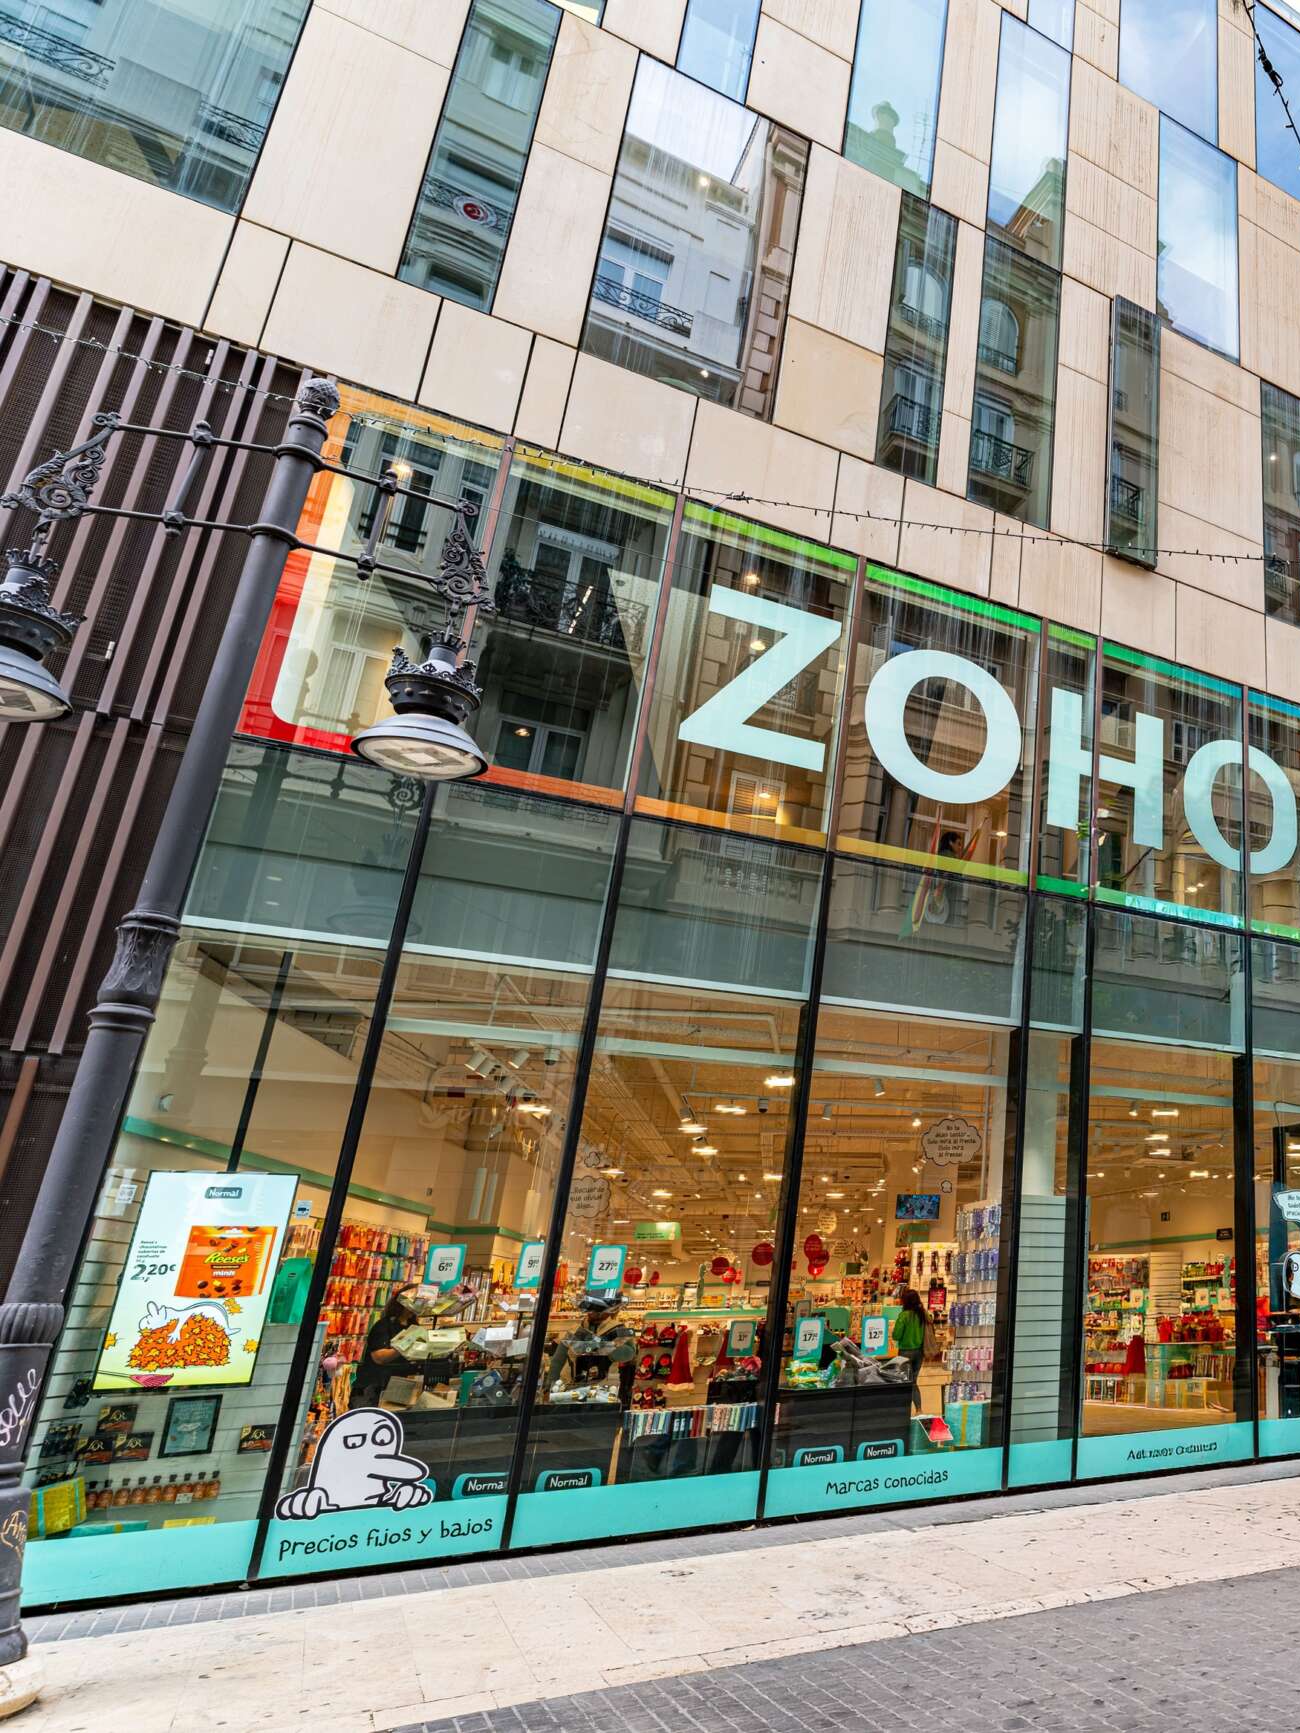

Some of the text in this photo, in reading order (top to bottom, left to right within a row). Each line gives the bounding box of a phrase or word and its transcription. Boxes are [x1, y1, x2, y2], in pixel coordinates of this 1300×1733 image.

[679, 584, 1298, 875] ZOHO
[130, 1264, 176, 1282] 2,20€
[804, 1452, 834, 1464] Normal
[867, 1445, 894, 1457] Normal
[467, 1478, 504, 1492] Norma
[549, 1475, 589, 1488] Normal
[826, 1470, 949, 1495] Marcas conocidas
[366, 1526, 412, 1548] fijos
[418, 1526, 432, 1545] y
[440, 1517, 494, 1538] bajos
